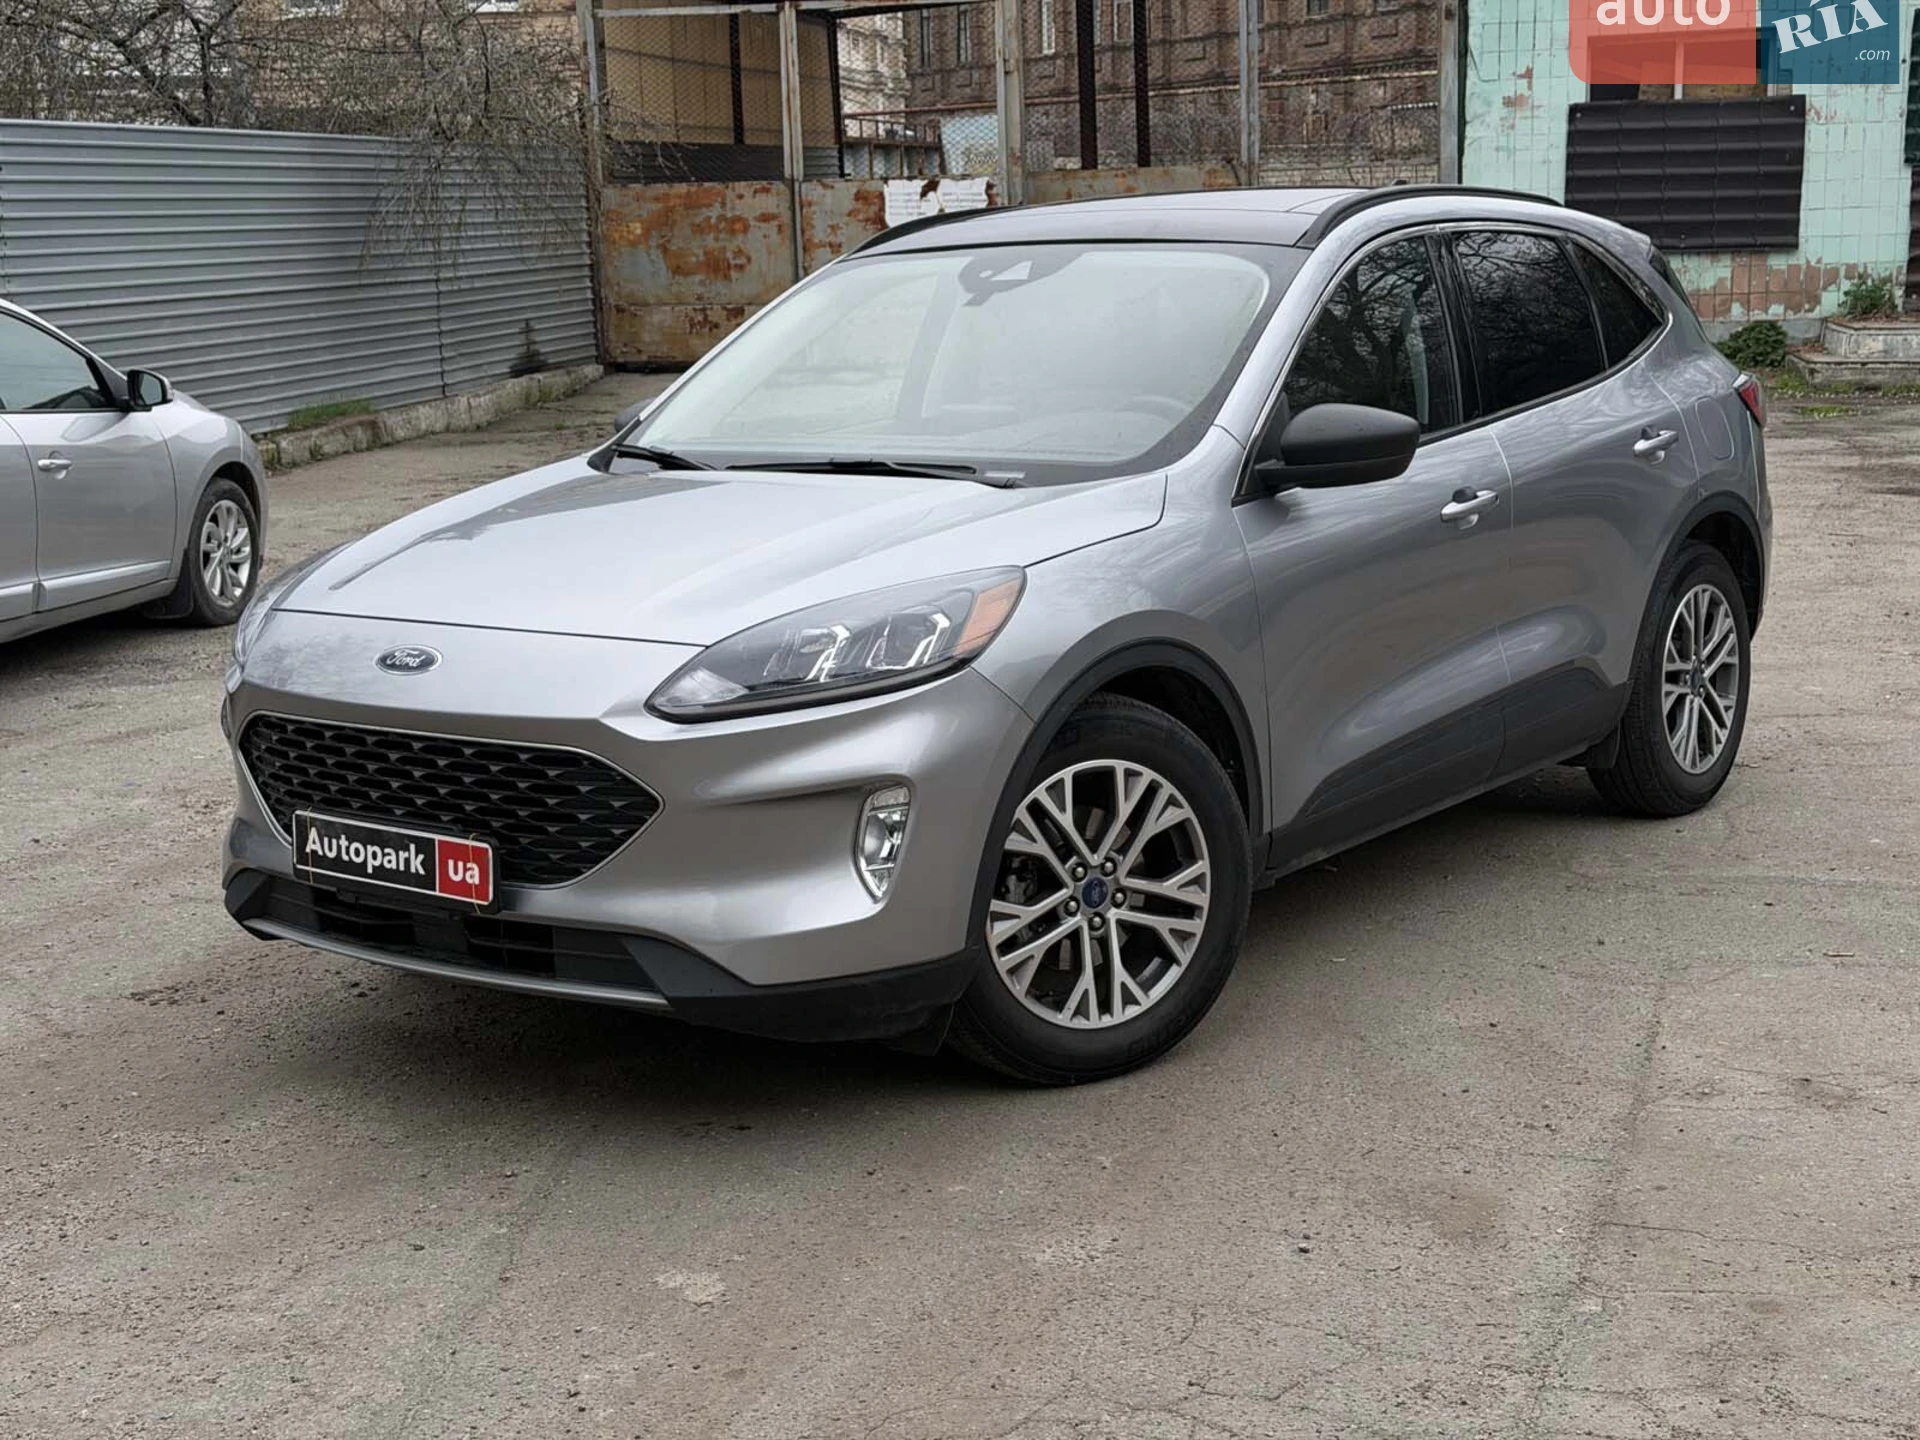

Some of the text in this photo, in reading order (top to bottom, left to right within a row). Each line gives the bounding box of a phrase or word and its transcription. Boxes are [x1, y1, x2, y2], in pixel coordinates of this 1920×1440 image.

[386, 648, 427, 667] Ford
[305, 827, 480, 885] Autopark ua
